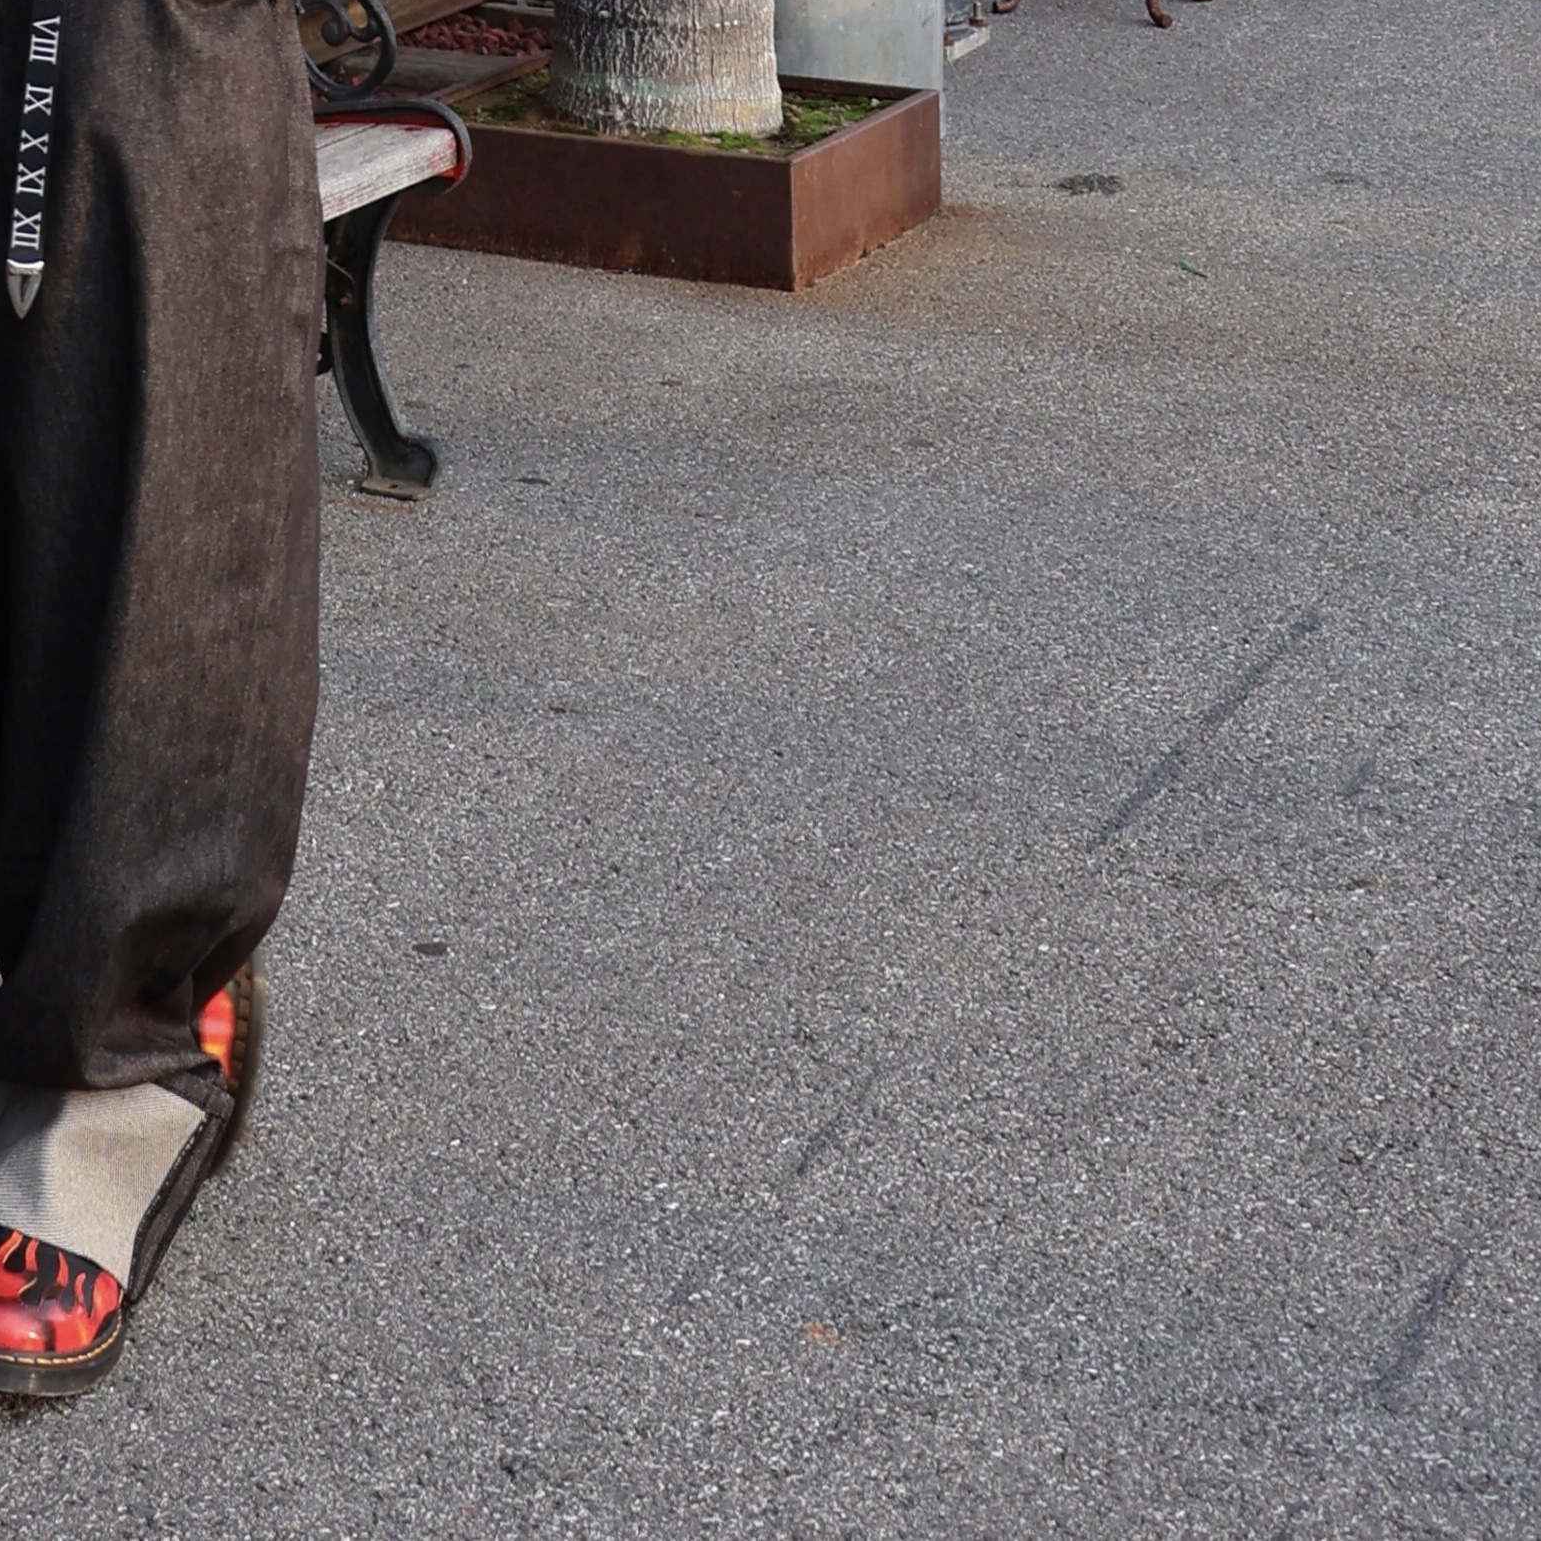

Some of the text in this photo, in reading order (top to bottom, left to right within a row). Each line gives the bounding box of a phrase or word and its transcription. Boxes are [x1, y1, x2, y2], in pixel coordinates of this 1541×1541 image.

[29, 15, 61, 65] VIII
[23, 83, 53, 116] IX
[20, 129, 49, 154] X
[16, 162, 46, 197] XI
[11, 208, 42, 250] XII
